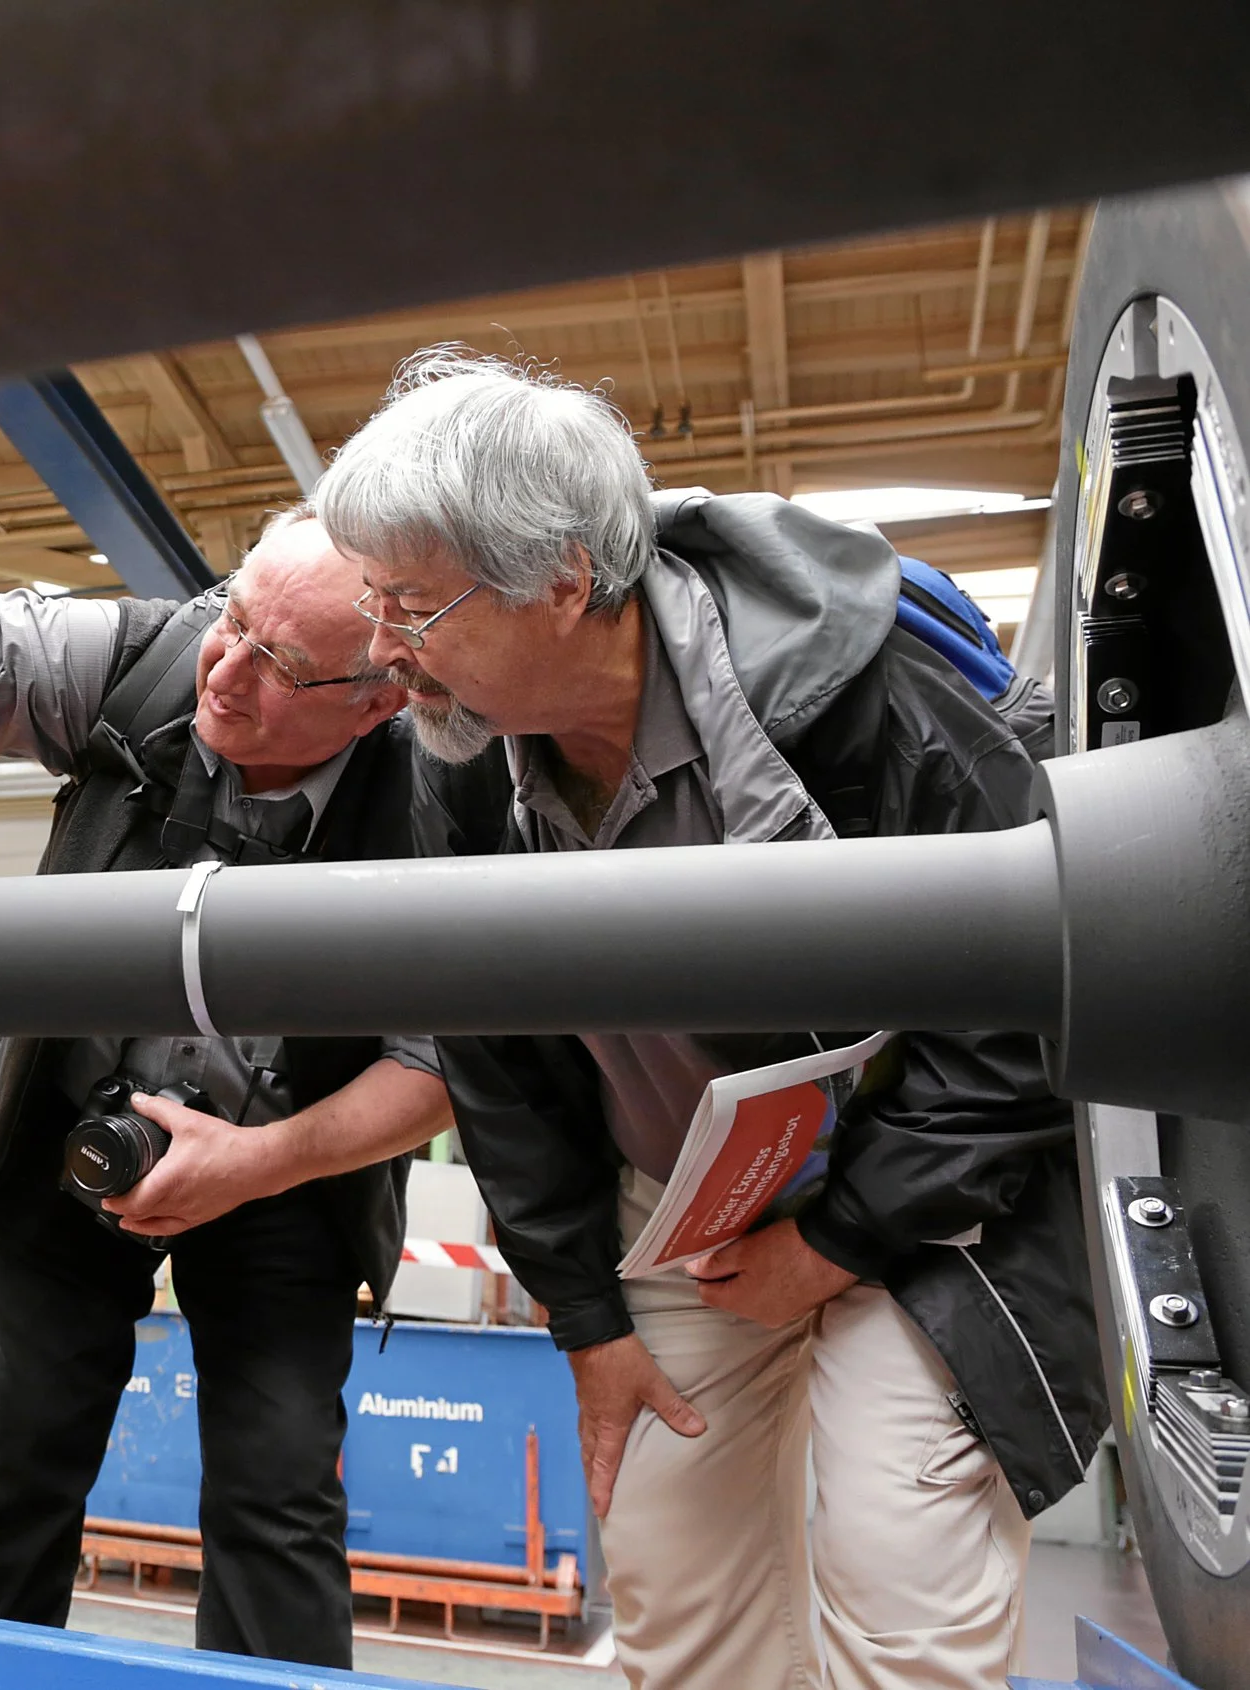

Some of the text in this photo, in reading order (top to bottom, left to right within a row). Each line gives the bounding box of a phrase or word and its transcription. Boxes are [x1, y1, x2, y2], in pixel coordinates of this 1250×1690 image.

[80, 1145, 109, 1170] Canon
[704, 1197, 740, 1236] Glacier
[732, 1146, 772, 1195] Express
[358, 1391, 483, 1422] Aluminium
